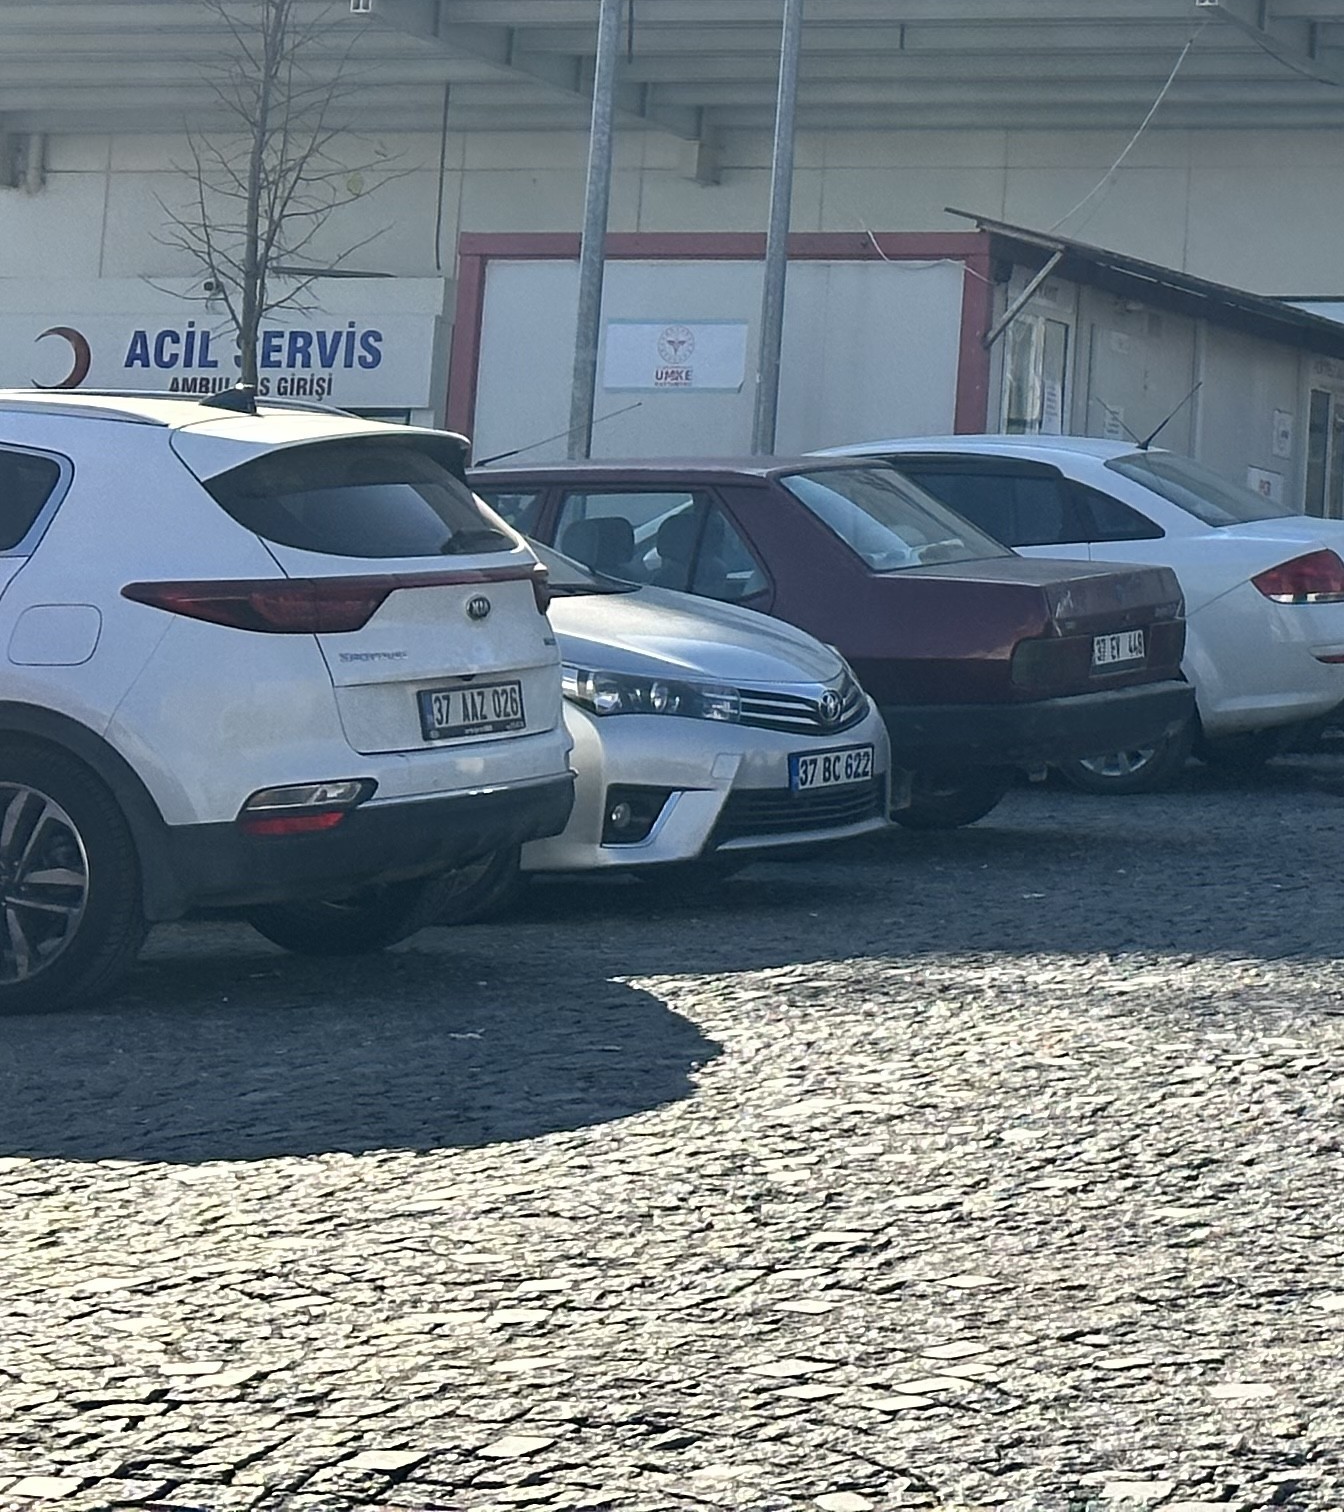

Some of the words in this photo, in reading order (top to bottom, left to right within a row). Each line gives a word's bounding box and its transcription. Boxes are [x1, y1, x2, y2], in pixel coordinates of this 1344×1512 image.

[124, 321, 218, 369] ACİL
[277, 373, 332, 402] GİRİŞİ
[655, 369, 693, 381] UMKE
[434, 694, 451, 726] 37
[462, 690, 488, 723] AAZ
[492, 687, 519, 719] 026
[800, 758, 818, 786] 37
[822, 755, 841, 783] BC
[845, 751, 870, 779] 622
